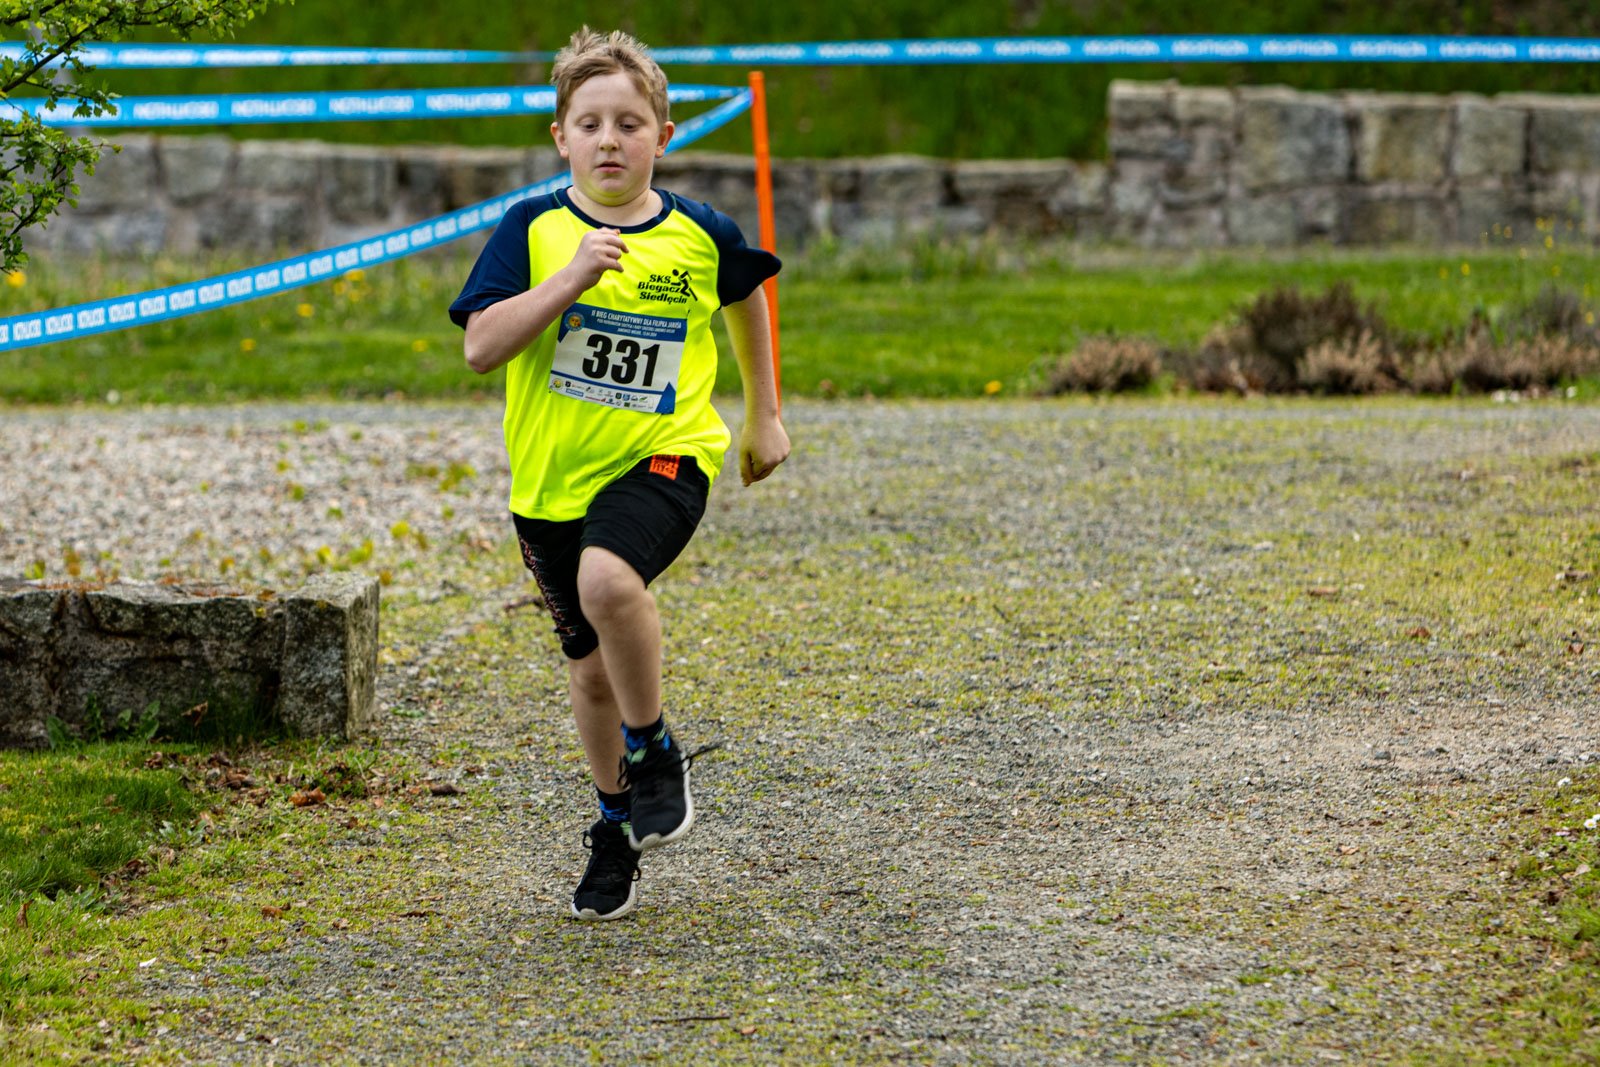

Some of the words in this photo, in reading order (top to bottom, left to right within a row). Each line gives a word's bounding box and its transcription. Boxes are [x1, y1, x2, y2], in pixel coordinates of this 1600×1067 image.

[649, 274, 671, 284] SKS
[637, 281, 681, 293] Biegacz
[582, 333, 660, 387] 331
